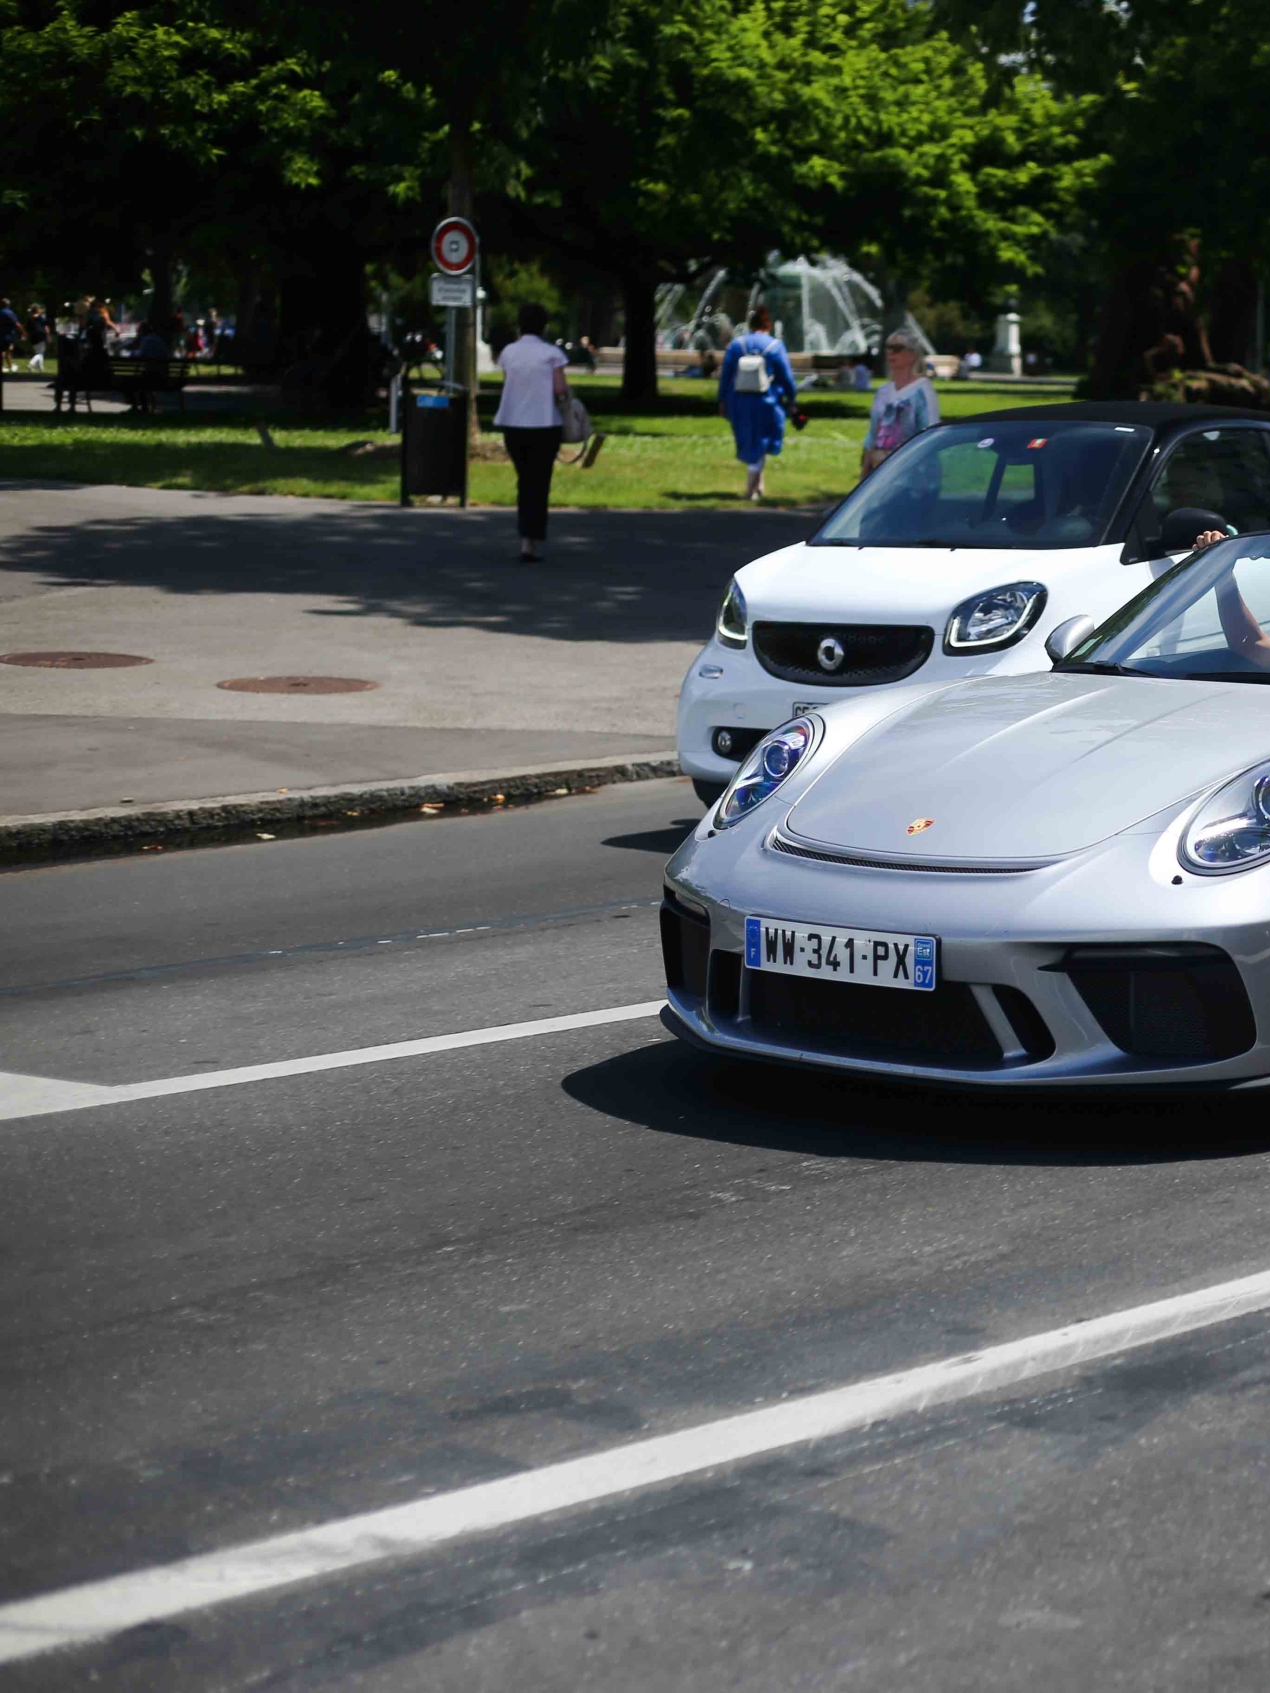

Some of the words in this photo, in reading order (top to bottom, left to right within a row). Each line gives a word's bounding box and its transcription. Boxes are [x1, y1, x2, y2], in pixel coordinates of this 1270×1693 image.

[750, 948, 756, 959] F
[765, 927, 910, 980] WW-341-PX
[915, 965, 932, 984] 67
